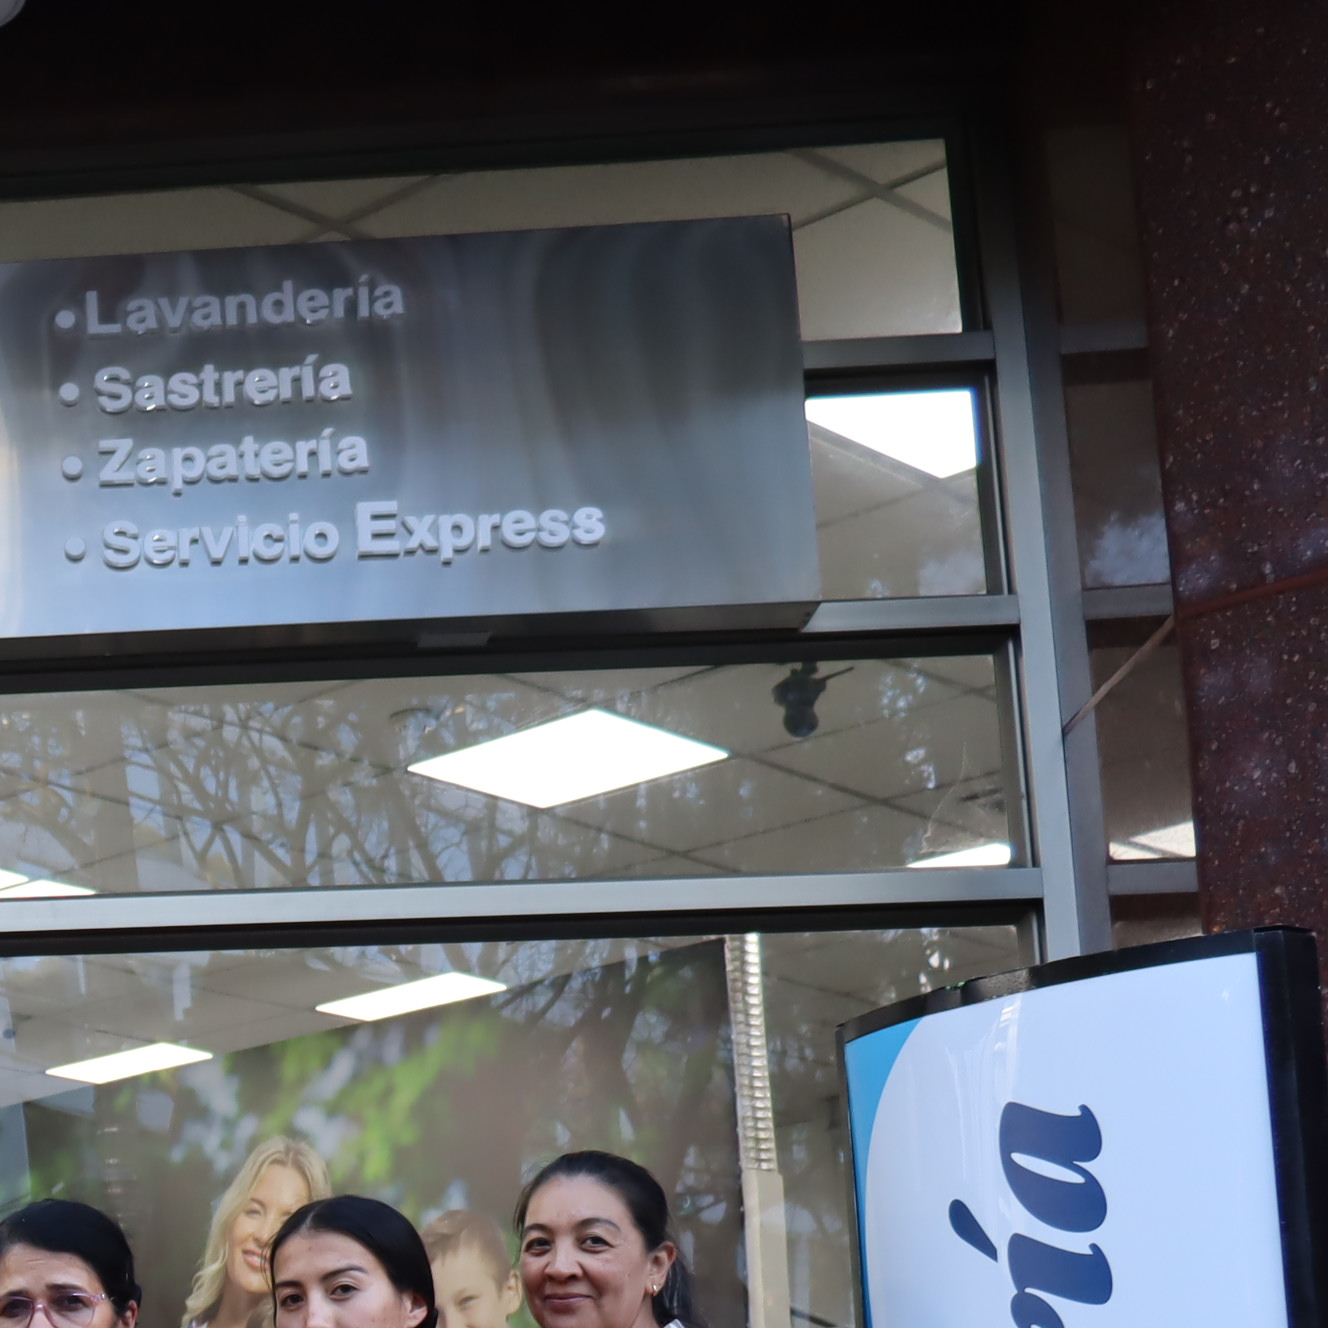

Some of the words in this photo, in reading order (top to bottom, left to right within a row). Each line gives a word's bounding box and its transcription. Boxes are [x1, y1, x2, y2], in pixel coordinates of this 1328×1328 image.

[85, 274, 404, 335] Lavandería
[94, 354, 352, 414] Sastrería
[97, 428, 370, 493] Zapatería
[101, 512, 340, 569] Servicio
[355, 500, 606, 565] Express
